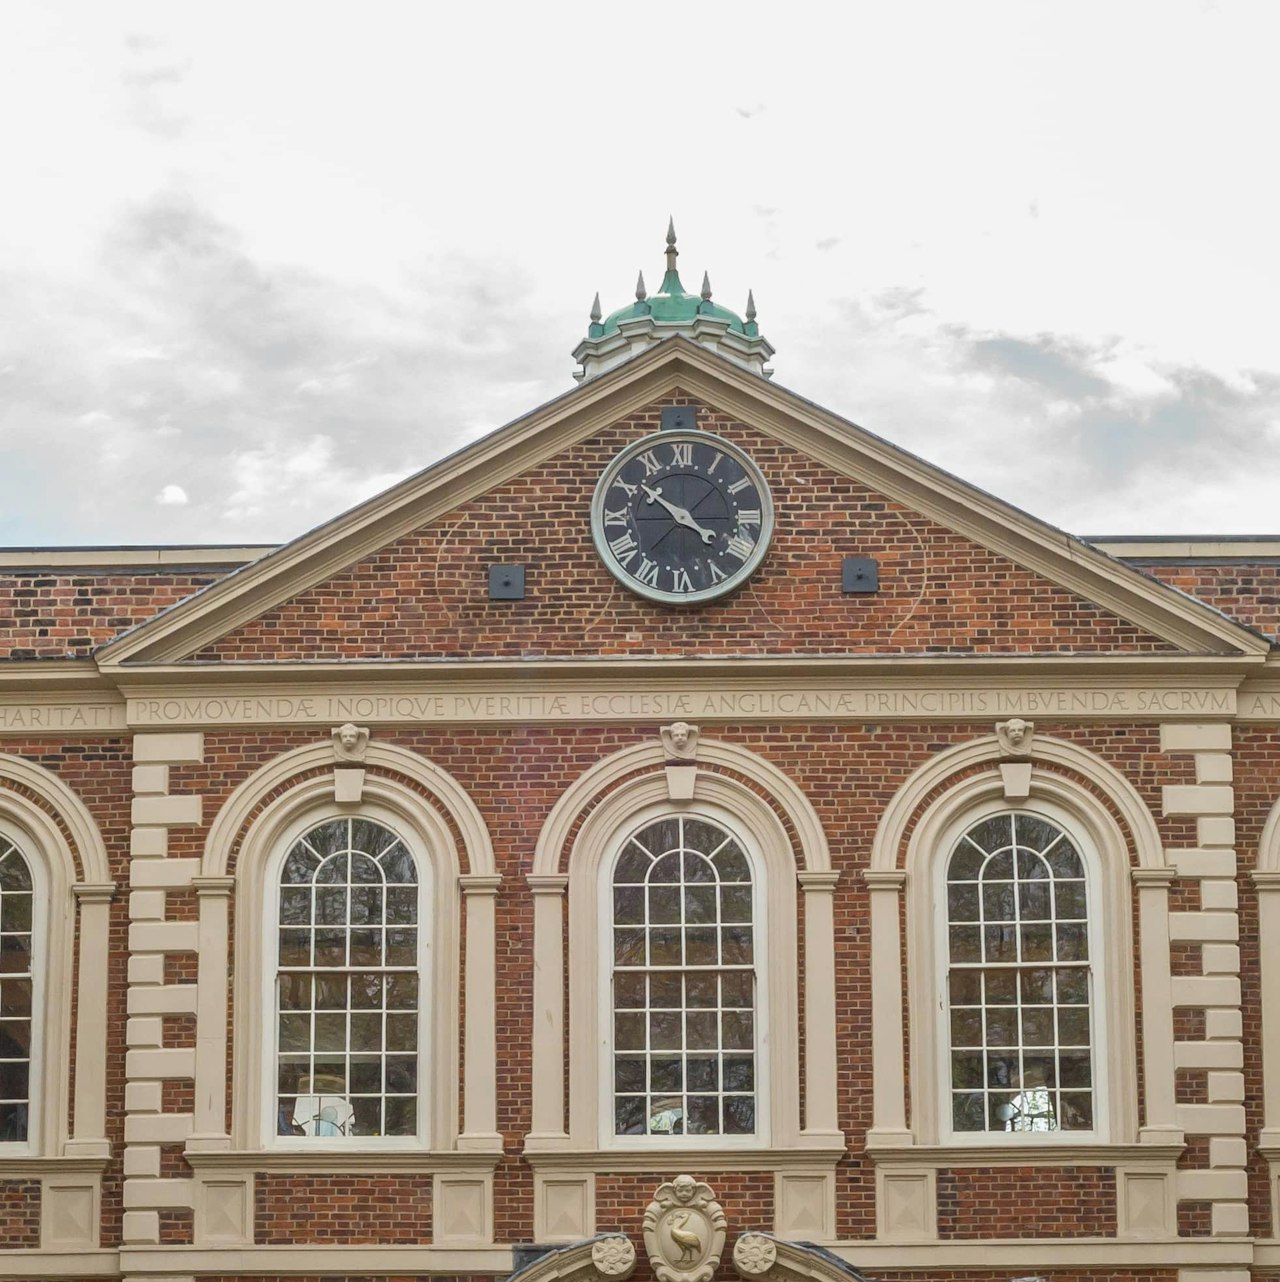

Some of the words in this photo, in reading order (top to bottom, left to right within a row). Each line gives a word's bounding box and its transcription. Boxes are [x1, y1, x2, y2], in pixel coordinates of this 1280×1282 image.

[636, 450, 663, 476] XI
[671, 444, 693, 466] XII
[707, 452, 724, 475] I
[612, 476, 638, 498] X
[728, 476, 753, 495] II
[604, 507, 628, 527] IX
[738, 509, 761, 525] III
[609, 532, 638, 568] VIII
[634, 558, 660, 588] VII
[672, 570, 696, 592] VI
[707, 562, 728, 584] V
[135, 698, 317, 721] PROMOVENDÆ
[328, 697, 444, 719] INOPIQVE
[454, 695, 570, 717] PVERITIÆ
[581, 694, 693, 715] ECCLESIÆ
[703, 693, 856, 714] ANGLICANÆ
[864, 692, 987, 713] PRINCIPIIS
[997, 691, 1129, 711] IMBVENDÆ
[1137, 690, 1231, 711] SACRVM
